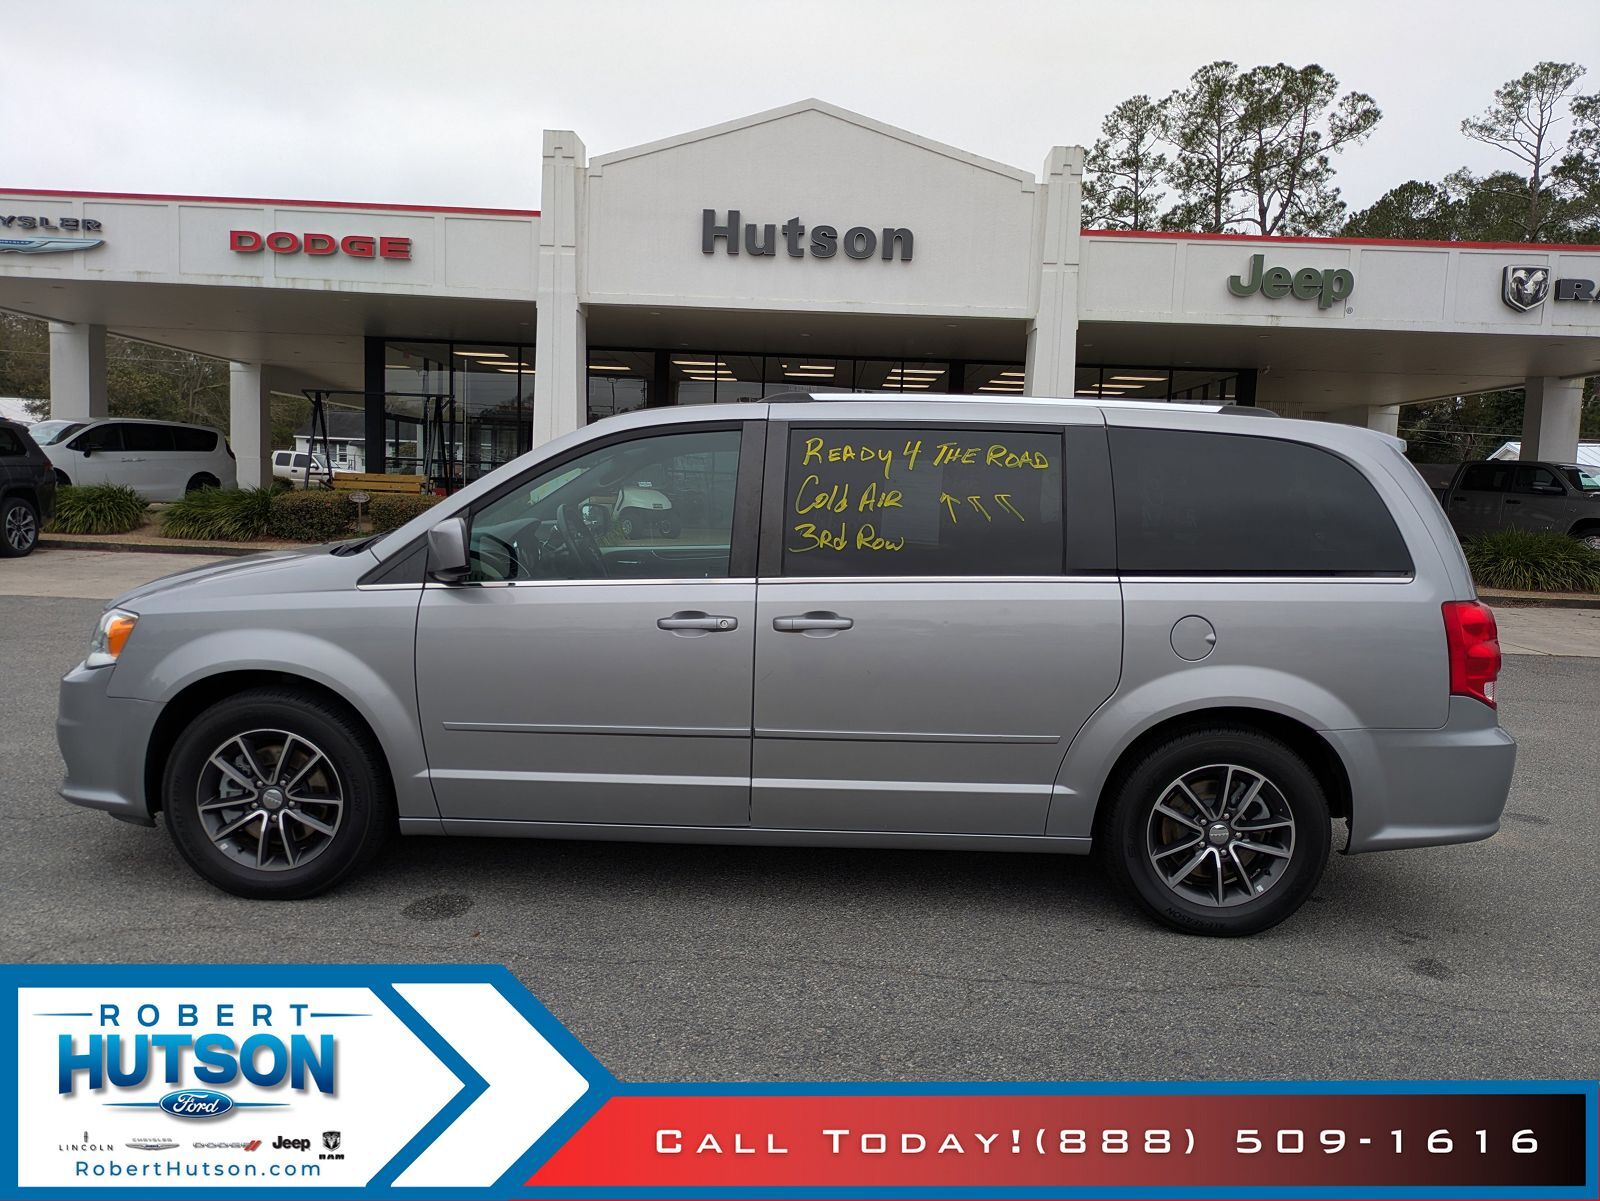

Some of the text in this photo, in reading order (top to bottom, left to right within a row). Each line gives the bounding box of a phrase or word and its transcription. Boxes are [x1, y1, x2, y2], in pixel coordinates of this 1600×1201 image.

[229, 230, 412, 260] DODGE
[702, 209, 914, 261] Hutson
[1227, 254, 1354, 310] Jeep
[1554, 279, 1600, 302] R
[903, 440, 922, 471] 4
[932, 442, 981, 467] THE
[986, 445, 1049, 469] ROAD
[795, 475, 849, 515] Cold
